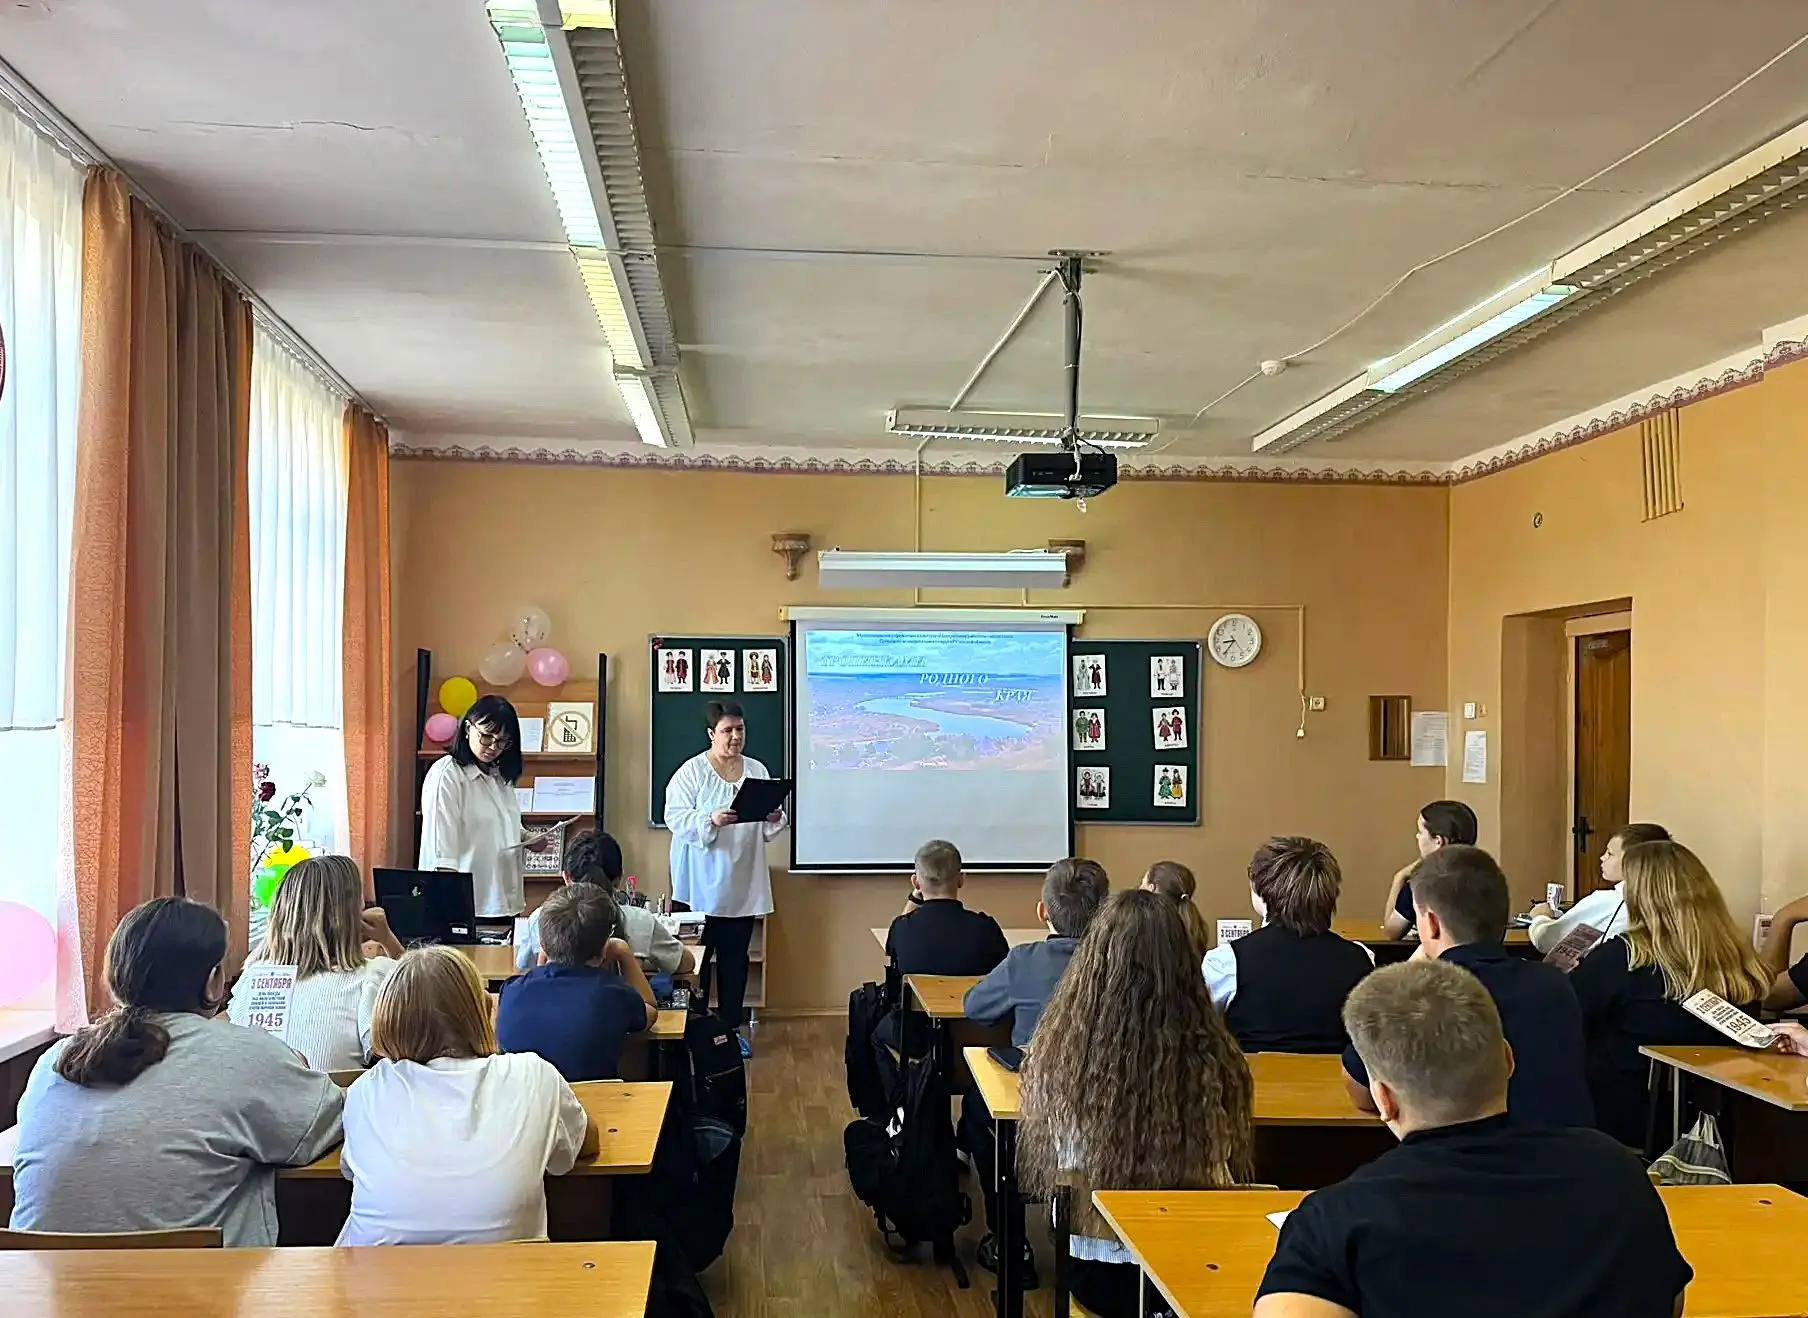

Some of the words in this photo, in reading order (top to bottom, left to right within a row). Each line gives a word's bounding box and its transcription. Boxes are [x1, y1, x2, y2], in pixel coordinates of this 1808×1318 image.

[920, 672, 989, 686] РОДНОГО
[993, 689, 1033, 703] КРАЯ
[251, 978, 256, 989] 3
[257, 978, 292, 989] СЕНТЯБРЯ
[248, 1013, 284, 1027] 1945
[1726, 1015, 1751, 1034] 1945
